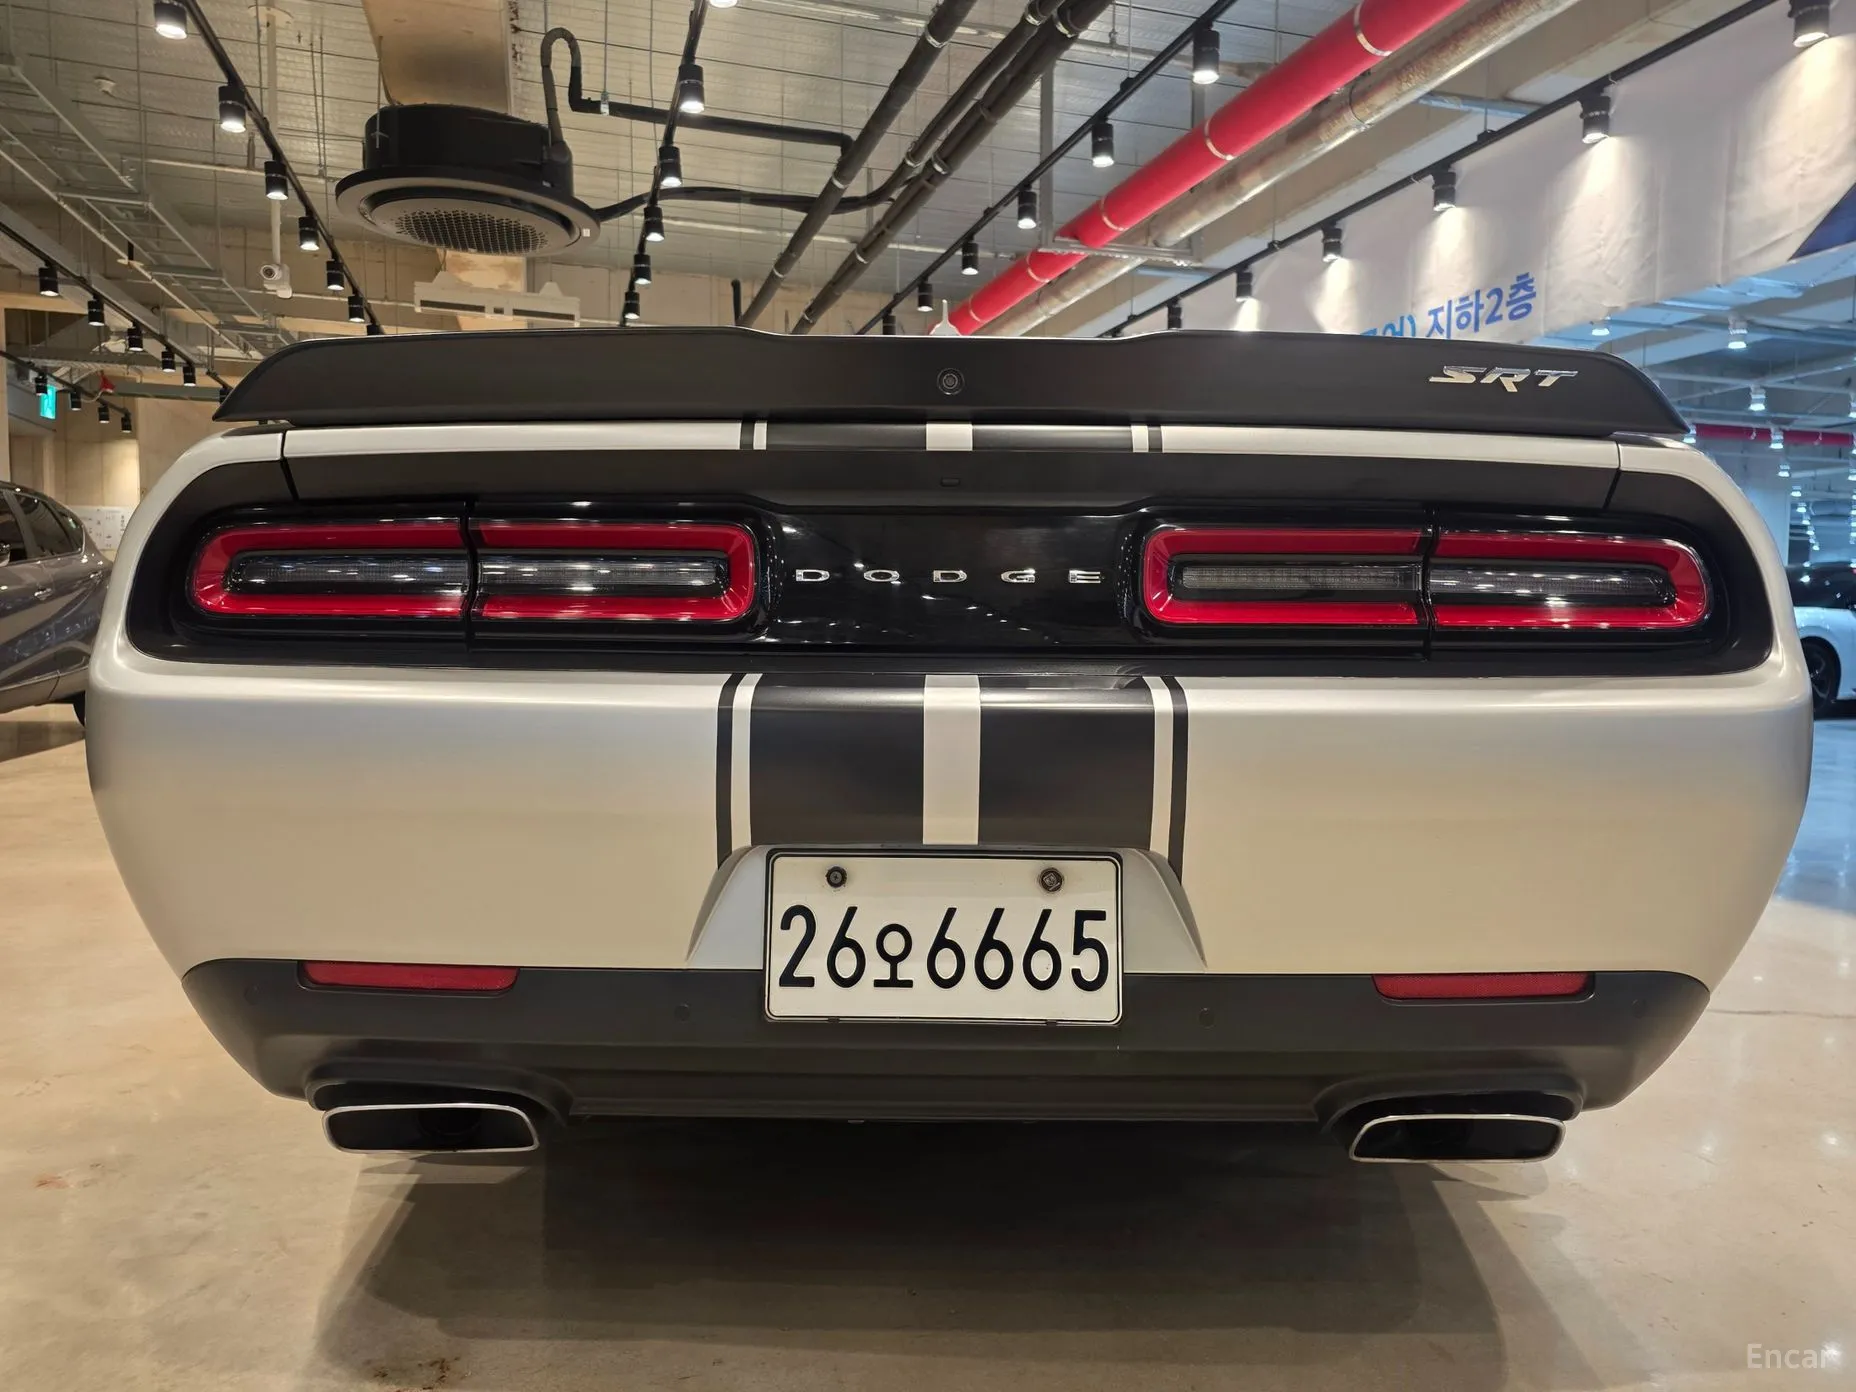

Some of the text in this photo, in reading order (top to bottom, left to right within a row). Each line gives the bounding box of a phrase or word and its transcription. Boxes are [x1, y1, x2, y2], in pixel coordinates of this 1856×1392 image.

[1426, 272, 1537, 339] 지하2층
[1429, 365, 1579, 392] SRT
[796, 569, 1101, 583] DODGE
[779, 904, 1109, 992] 26오6665
